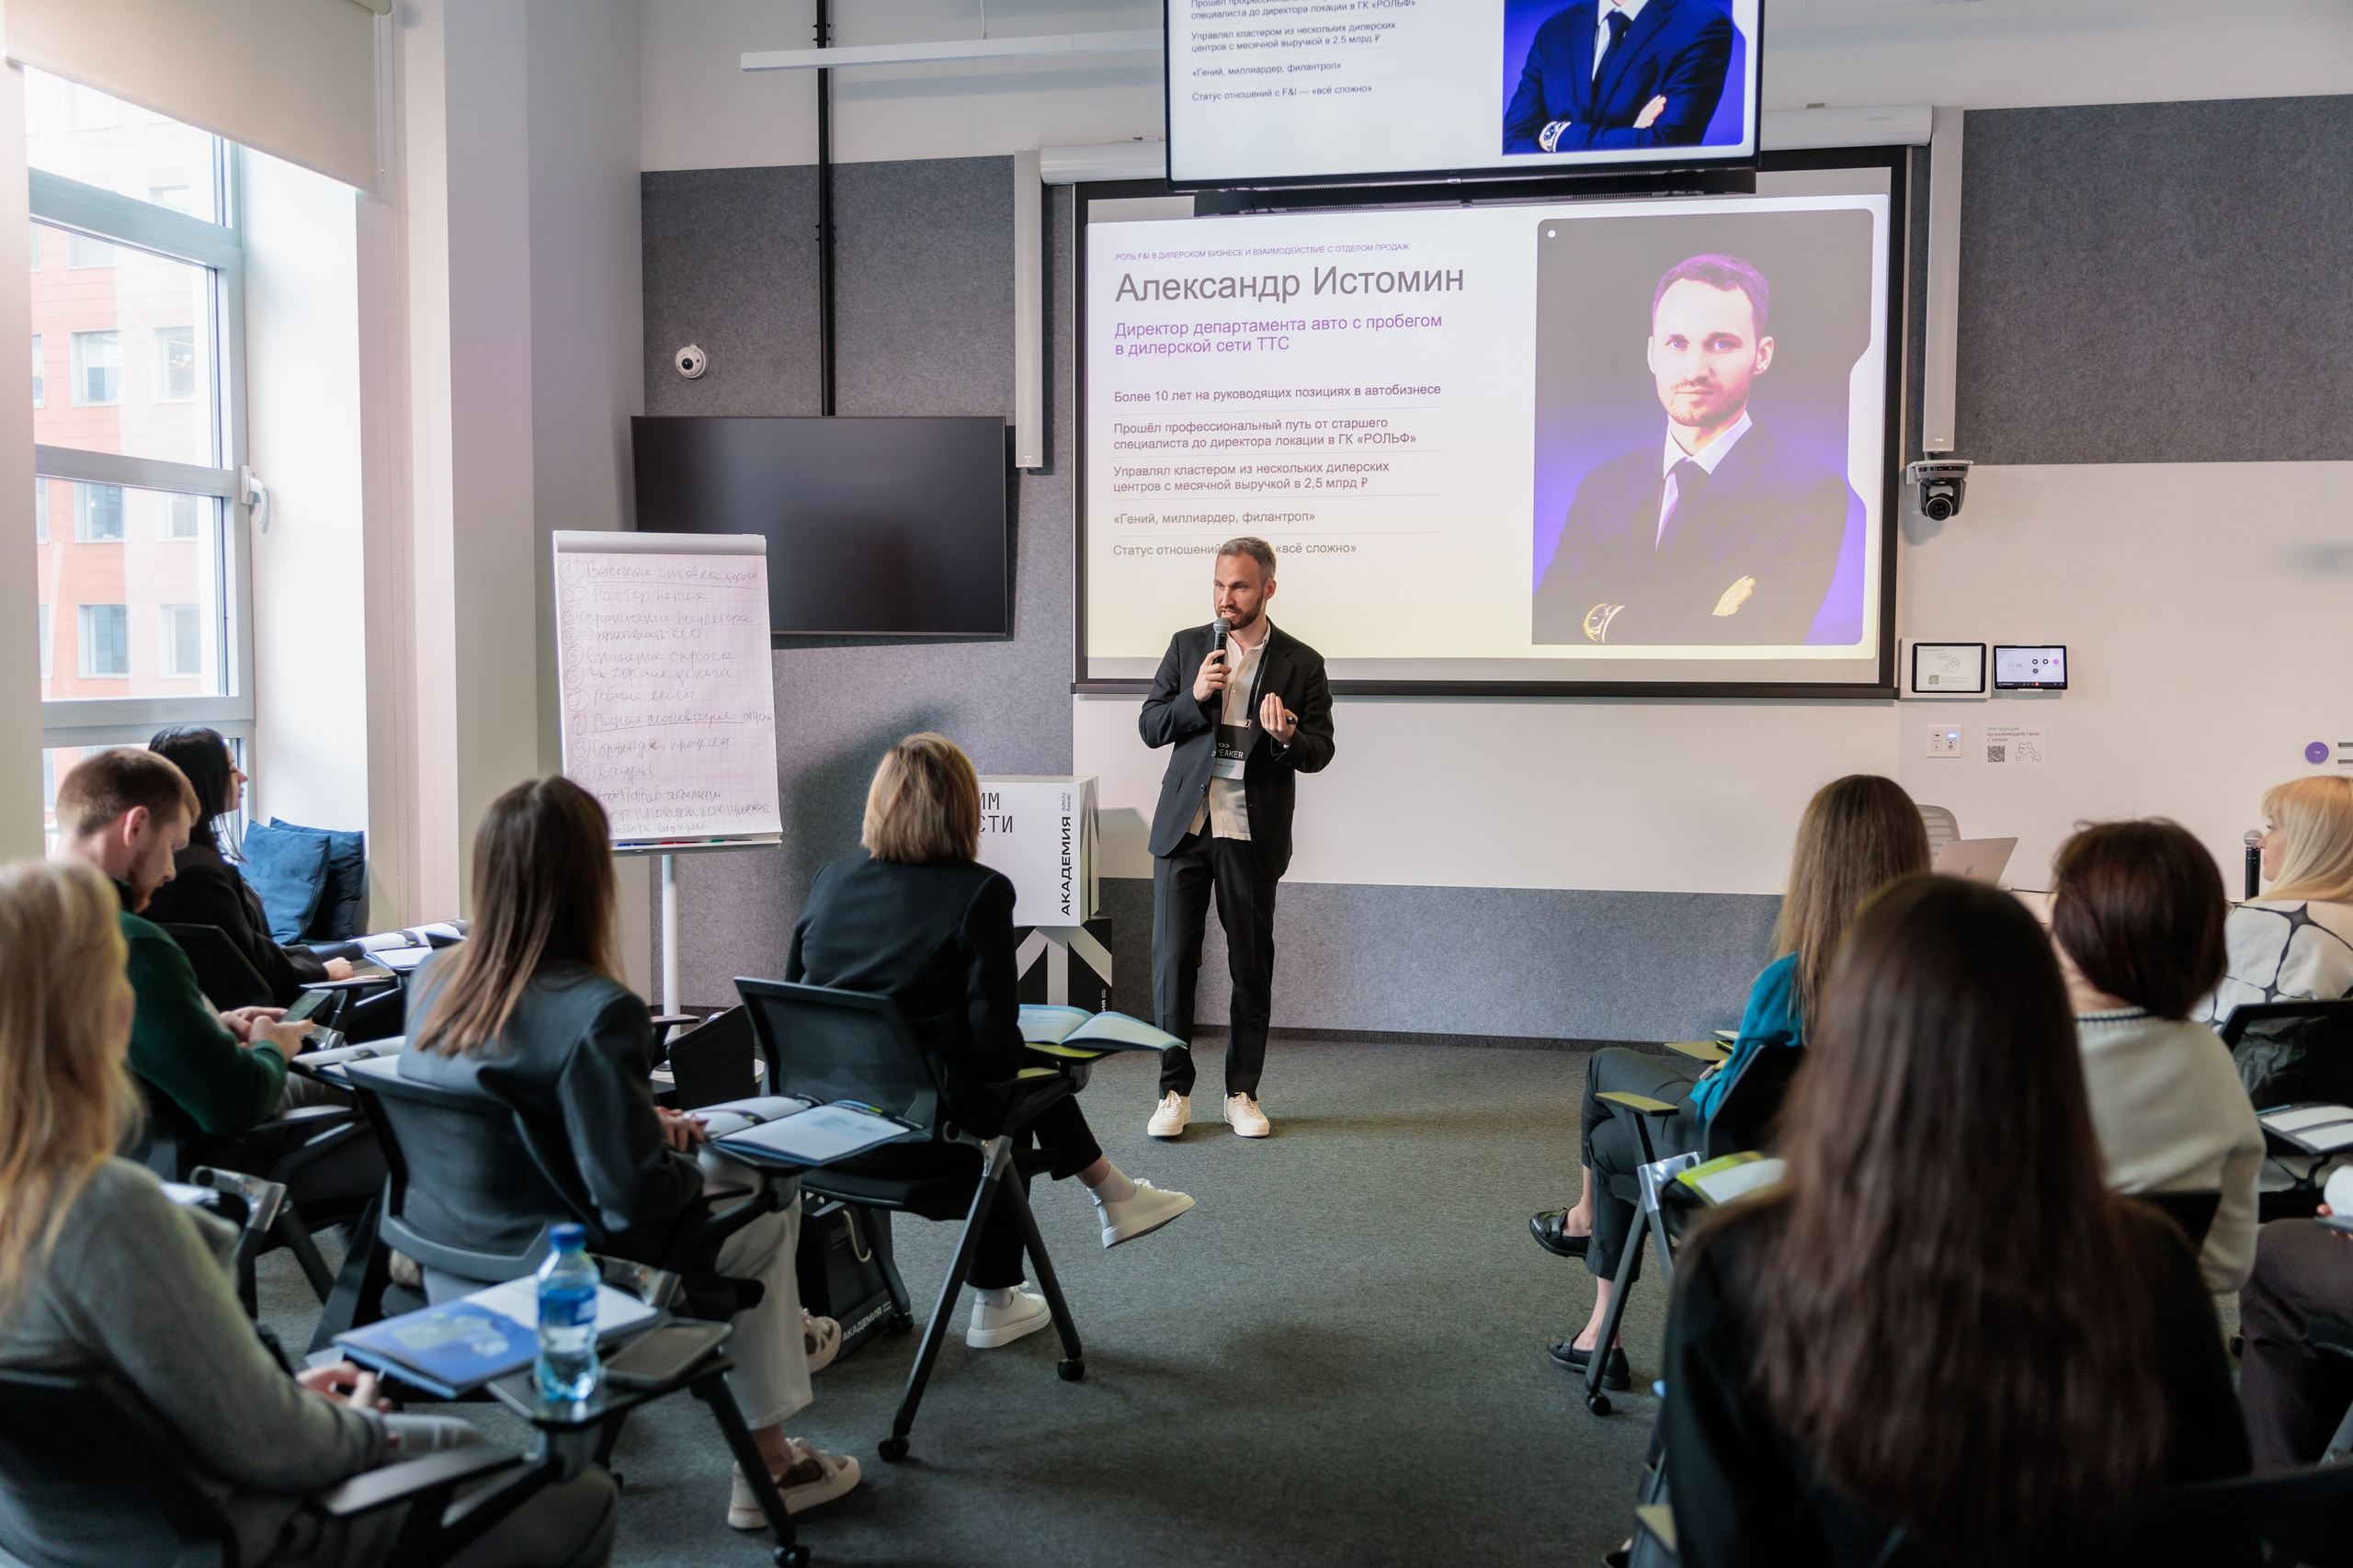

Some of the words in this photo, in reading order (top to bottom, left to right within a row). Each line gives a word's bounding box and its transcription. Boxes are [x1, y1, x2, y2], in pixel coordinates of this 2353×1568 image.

[1190, 9, 1246, 19] специалиста
[1261, 6, 1308, 17] директора
[1310, 4, 1347, 12] локации
[1357, 0, 1369, 9] ГК
[1370, 0, 1415, 8] «РОЛЬФ»
[1190, 31, 1233, 41] Управлял
[1235, 28, 1281, 38] кластером
[1296, 25, 1346, 34] нескольких
[1347, 21, 1395, 32] дилерских
[1191, 43, 1226, 53] центров
[1235, 39, 1279, 49] месячной
[1280, 36, 1323, 48] выручкой
[1332, 35, 1347, 44] 2,5
[1348, 35, 1372, 44] млрд
[1191, 67, 1225, 76] «Гений,
[1227, 65, 1284, 74] миллиардер,
[1286, 62, 1341, 74] филантроп»
[1191, 92, 1222, 102] Статус
[1223, 88, 1272, 99] отношений
[1281, 86, 1296, 96] F&I
[1312, 85, 1332, 95] «всё
[1334, 85, 1371, 94] сложно»
[1157, 250, 1206, 259] ДИЛЕРСКОМ
[1207, 248, 1243, 256] БИЗНЕСЕ
[1252, 245, 1325, 256] ВЗАИМОДЕЙСТВИЕ
[1335, 244, 1373, 253] ОТДЕЛОМ
[1374, 243, 1409, 251] ПРОДАЖ
[1114, 272, 1300, 303] Александр
[1313, 265, 1463, 295] Истомин
[1114, 322, 1188, 339] Директор
[1192, 319, 1306, 336] департамента
[1311, 318, 1347, 330] авто
[1352, 318, 1361, 329] с
[1366, 312, 1441, 332] пробегом
[1115, 344, 1123, 355] в
[1127, 338, 1211, 357] дилерской
[1216, 340, 1251, 352] сети
[1256, 335, 1289, 350] ТТС
[1114, 391, 1151, 402] Более
[1154, 390, 1168, 401] 10
[1171, 392, 1192, 401] лет
[1195, 391, 1210, 400] на
[1212, 389, 1291, 402] руководящих
[1295, 387, 1350, 398] позициях
[1354, 387, 1361, 396] в
[1364, 383, 1441, 395] автобизнесе
[1113, 422, 1161, 436] Прошёл
[1165, 418, 1281, 435] профессиональный
[1285, 420, 1312, 432] путь
[1314, 420, 1328, 428] от
[1331, 418, 1388, 430] старшего
[1113, 439, 1188, 450] специалиста
[1191, 438, 1207, 449] до
[1209, 437, 1271, 449] директора
[1274, 436, 1324, 447] локации
[1327, 436, 1335, 444] в
[1338, 433, 1353, 444] ГК
[1357, 432, 1416, 444] «РОЛЬФ»
[1113, 465, 1170, 479] Управлял
[1174, 465, 1235, 477] кластером
[1239, 465, 1253, 473] из
[1256, 463, 1323, 473] нескольких
[1325, 462, 1389, 474] дилерских
[1113, 483, 1161, 494] центров
[1164, 482, 1171, 491] с
[1174, 479, 1231, 490] месячной
[1234, 477, 1290, 492] выручкой
[1293, 480, 1301, 488] в
[1303, 477, 1323, 490] 2,5
[1325, 479, 1357, 490] млрд
[1113, 512, 1158, 525] «Гений,
[1162, 513, 1238, 525] миллиардер,
[1242, 511, 1315, 524] филантроп»
[1113, 544, 1154, 557] Статус
[1156, 543, 1221, 555] отношений
[1275, 541, 1302, 553] «всё
[1305, 544, 1357, 553] сложно»
[1061, 816, 1073, 916] АКАДЕМИЯ
[842, 1305, 882, 1342] АКАДЕМИЯ
